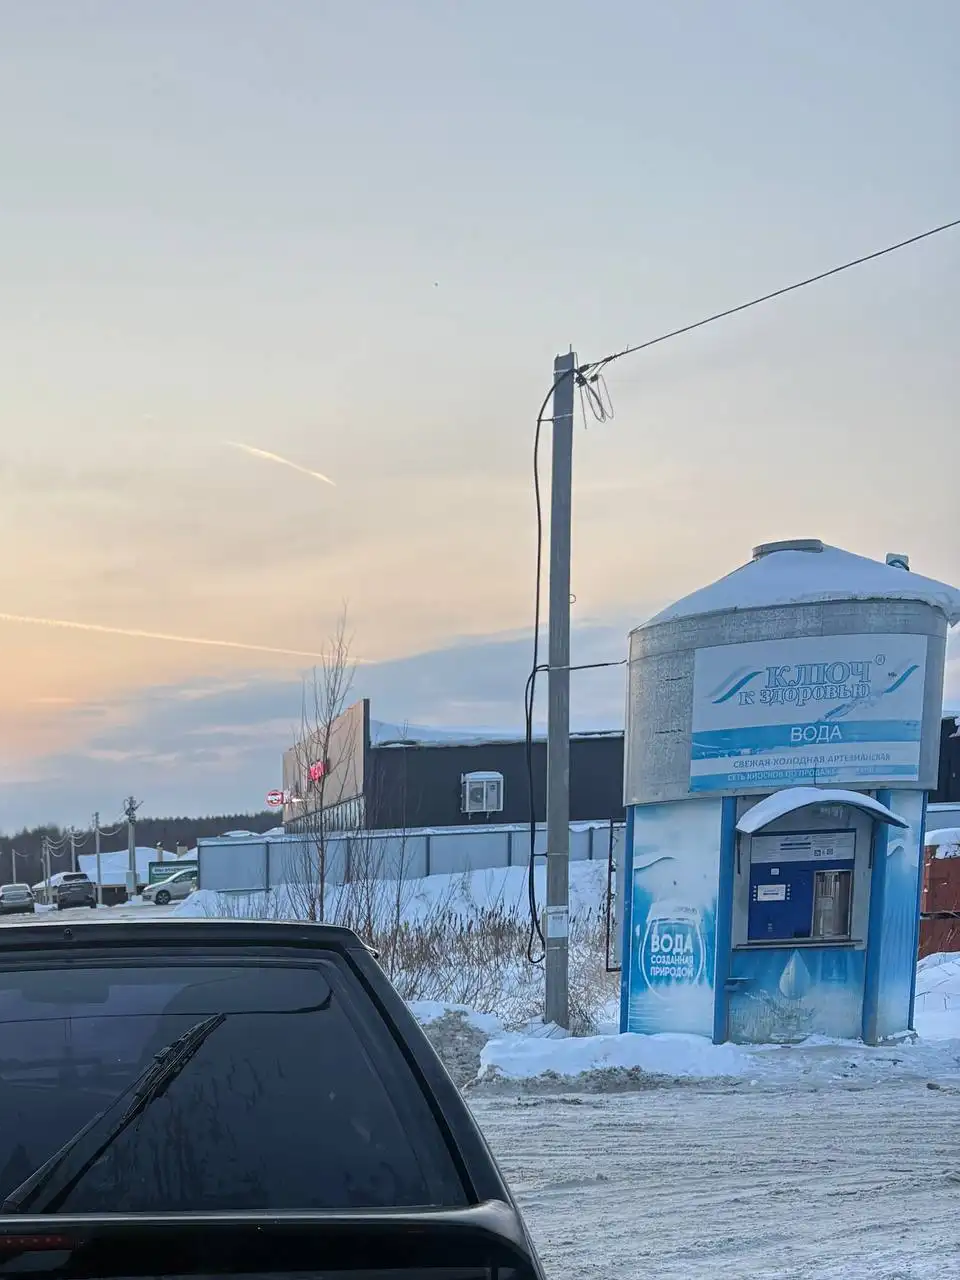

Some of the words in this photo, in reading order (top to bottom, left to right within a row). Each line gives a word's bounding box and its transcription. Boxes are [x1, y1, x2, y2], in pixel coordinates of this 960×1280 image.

[765, 661, 872, 688] КЛЮЧ
[790, 725, 843, 743] ВОДА
[650, 933, 693, 955] ВОДА
[650, 955, 694, 965] СОЗДАННАЯ
[650, 965, 694, 977] ПРИРОДОЙ
